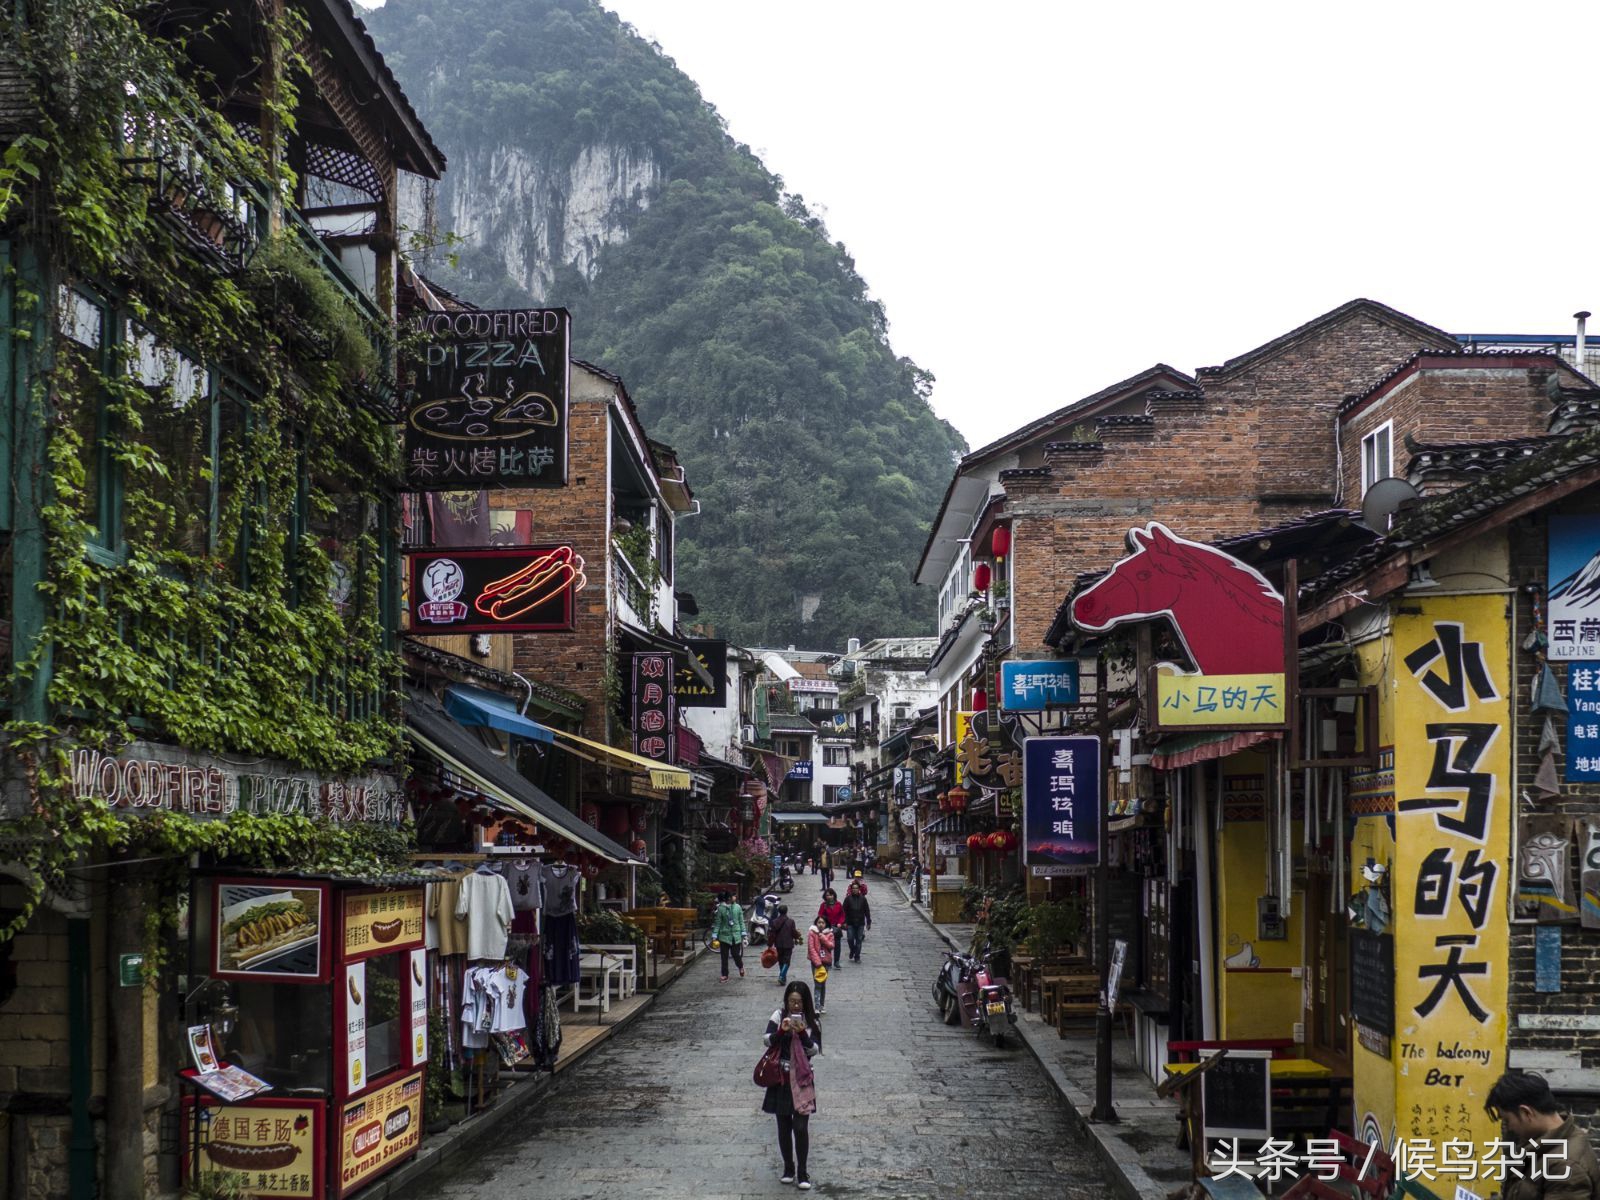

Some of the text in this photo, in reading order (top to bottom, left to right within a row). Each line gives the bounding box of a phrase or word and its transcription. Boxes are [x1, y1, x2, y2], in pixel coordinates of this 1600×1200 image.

[426, 339, 546, 381] PIZZA
[411, 446, 554, 479] 柴火烤比萨
[1555, 645, 1595, 657] ALPINE
[1572, 669, 1600, 692] 桂
[641, 657, 665, 757] 双月酒吧
[1162, 685, 1279, 713] 小马的天
[1573, 724, 1600, 740] 电话
[69, 749, 237, 814] WOODFIRED
[1398, 620, 1502, 1025] 小马的天
[1401, 1041, 1491, 1066] The balcony
[1424, 1067, 1465, 1087] Bar
[213, 1117, 292, 1142] 德国香肠
[343, 1131, 419, 1183] German Sausage
